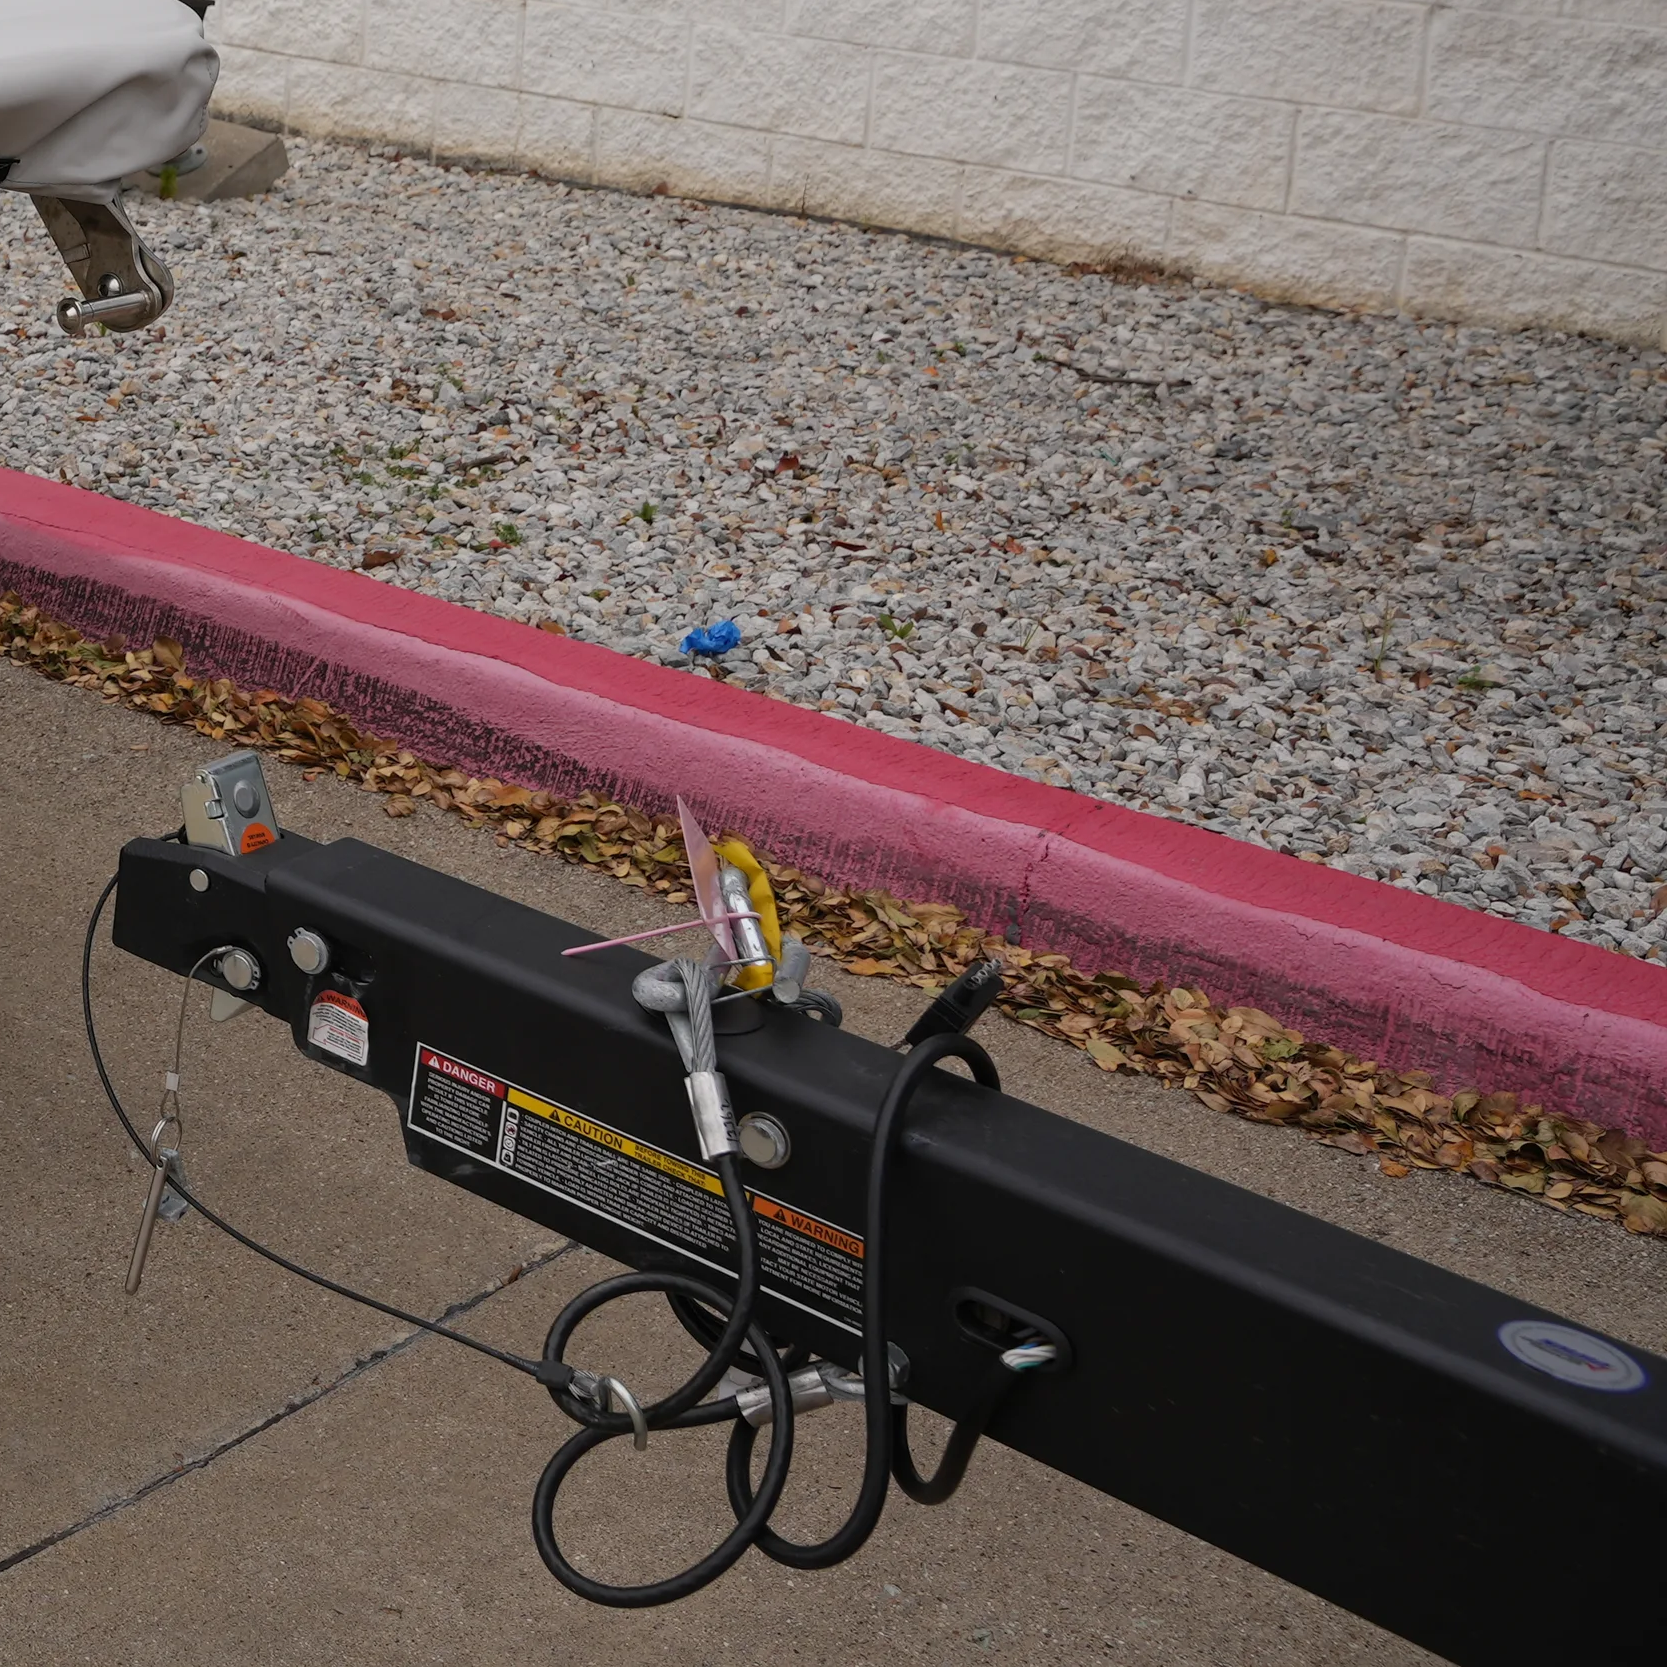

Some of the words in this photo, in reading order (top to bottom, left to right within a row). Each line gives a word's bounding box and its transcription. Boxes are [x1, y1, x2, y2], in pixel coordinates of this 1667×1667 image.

[442, 1060, 495, 1093] DANGER
[564, 1114, 622, 1150] CAUTION
[634, 1151, 661, 1168] TRAILER
[663, 1164, 687, 1179] CHECK
[635, 1144, 660, 1160] BEFORE
[663, 1156, 689, 1173] TOWING
[691, 1169, 705, 1180] THIS
[791, 1214, 859, 1255] WARNING
